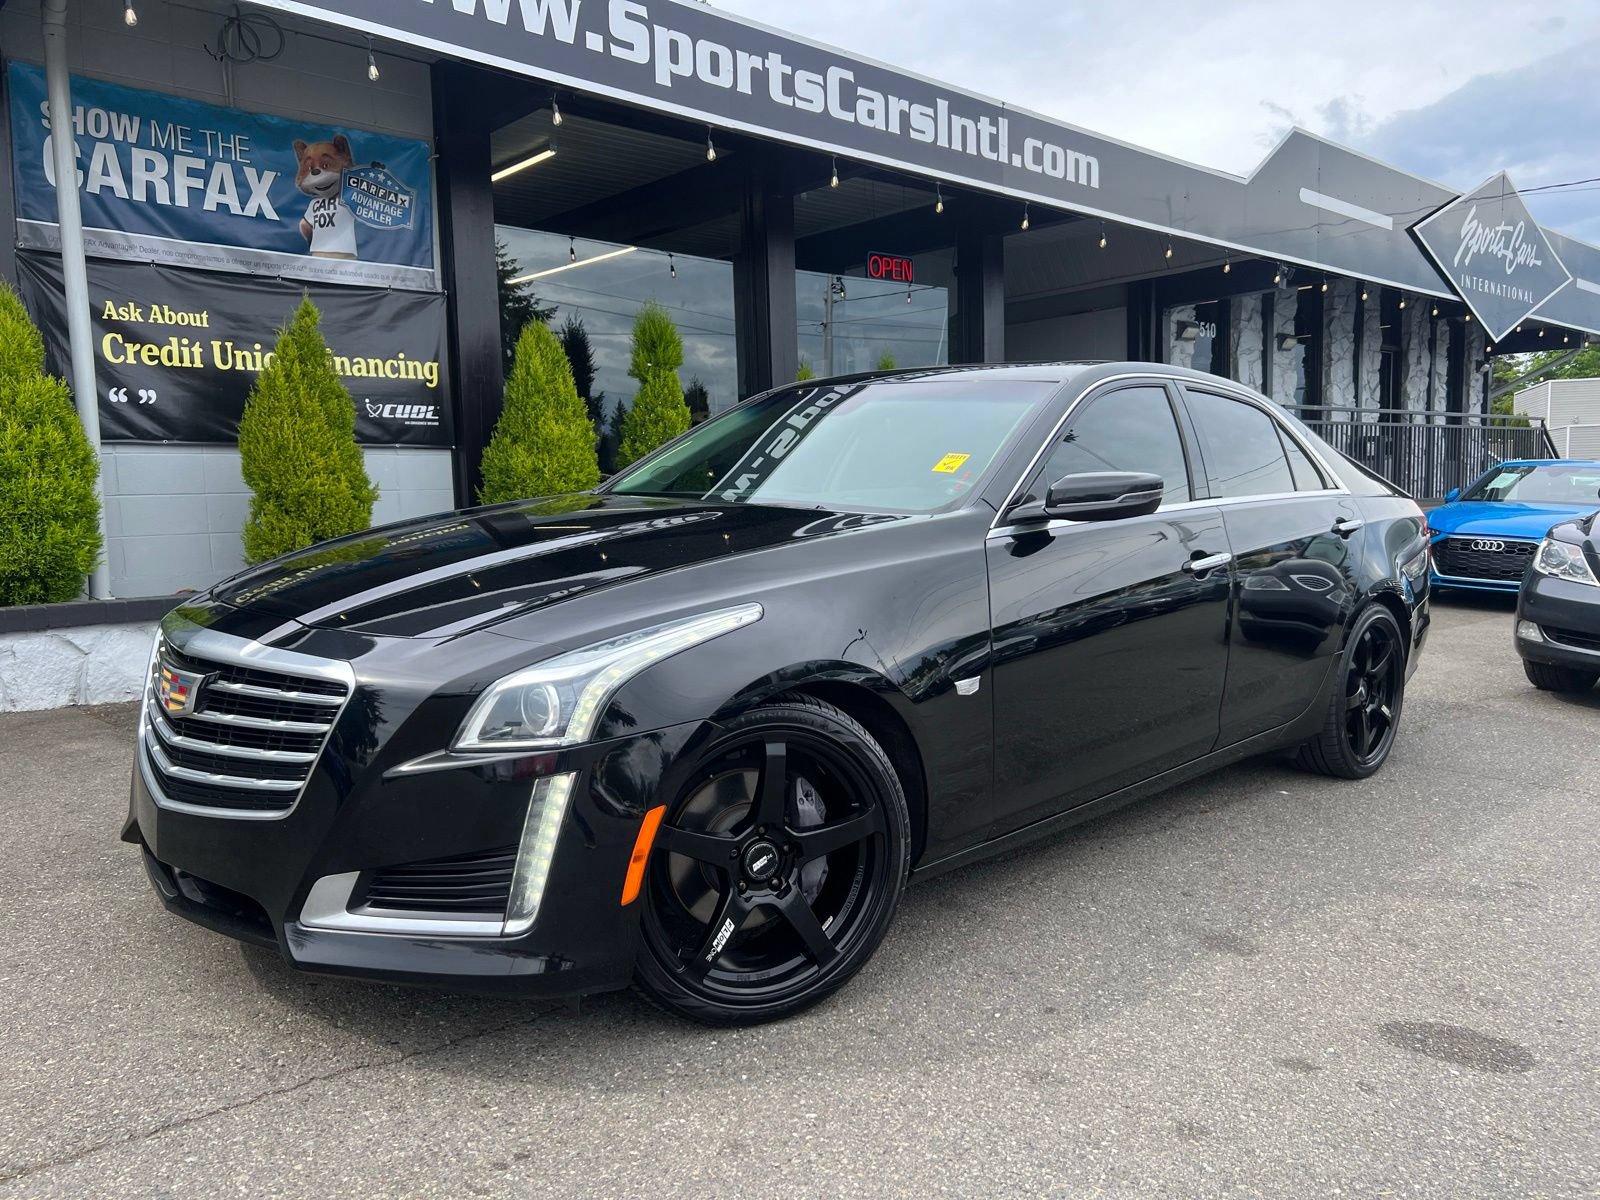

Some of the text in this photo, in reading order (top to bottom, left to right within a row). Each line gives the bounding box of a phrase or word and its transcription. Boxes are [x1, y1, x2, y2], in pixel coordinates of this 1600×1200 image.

[418, 0, 1100, 189] W.SportsCarsIntl.com
[151, 119, 192, 153] ME
[199, 129, 251, 163] THE
[43, 134, 280, 221] CARFAX
[312, 196, 337, 212] CAR
[347, 176, 410, 208] CARFAX
[351, 192, 404, 218] ADVANTAGE
[313, 212, 336, 229] FOX
[356, 206, 392, 226] DEALER
[869, 255, 912, 282] OPEN
[1461, 274, 1534, 303] INTERNATIONAL
[102, 301, 209, 328] Ask About
[102, 332, 204, 369] Credit
[210, 341, 277, 372] Unio
[382, 404, 439, 419] CUDL
